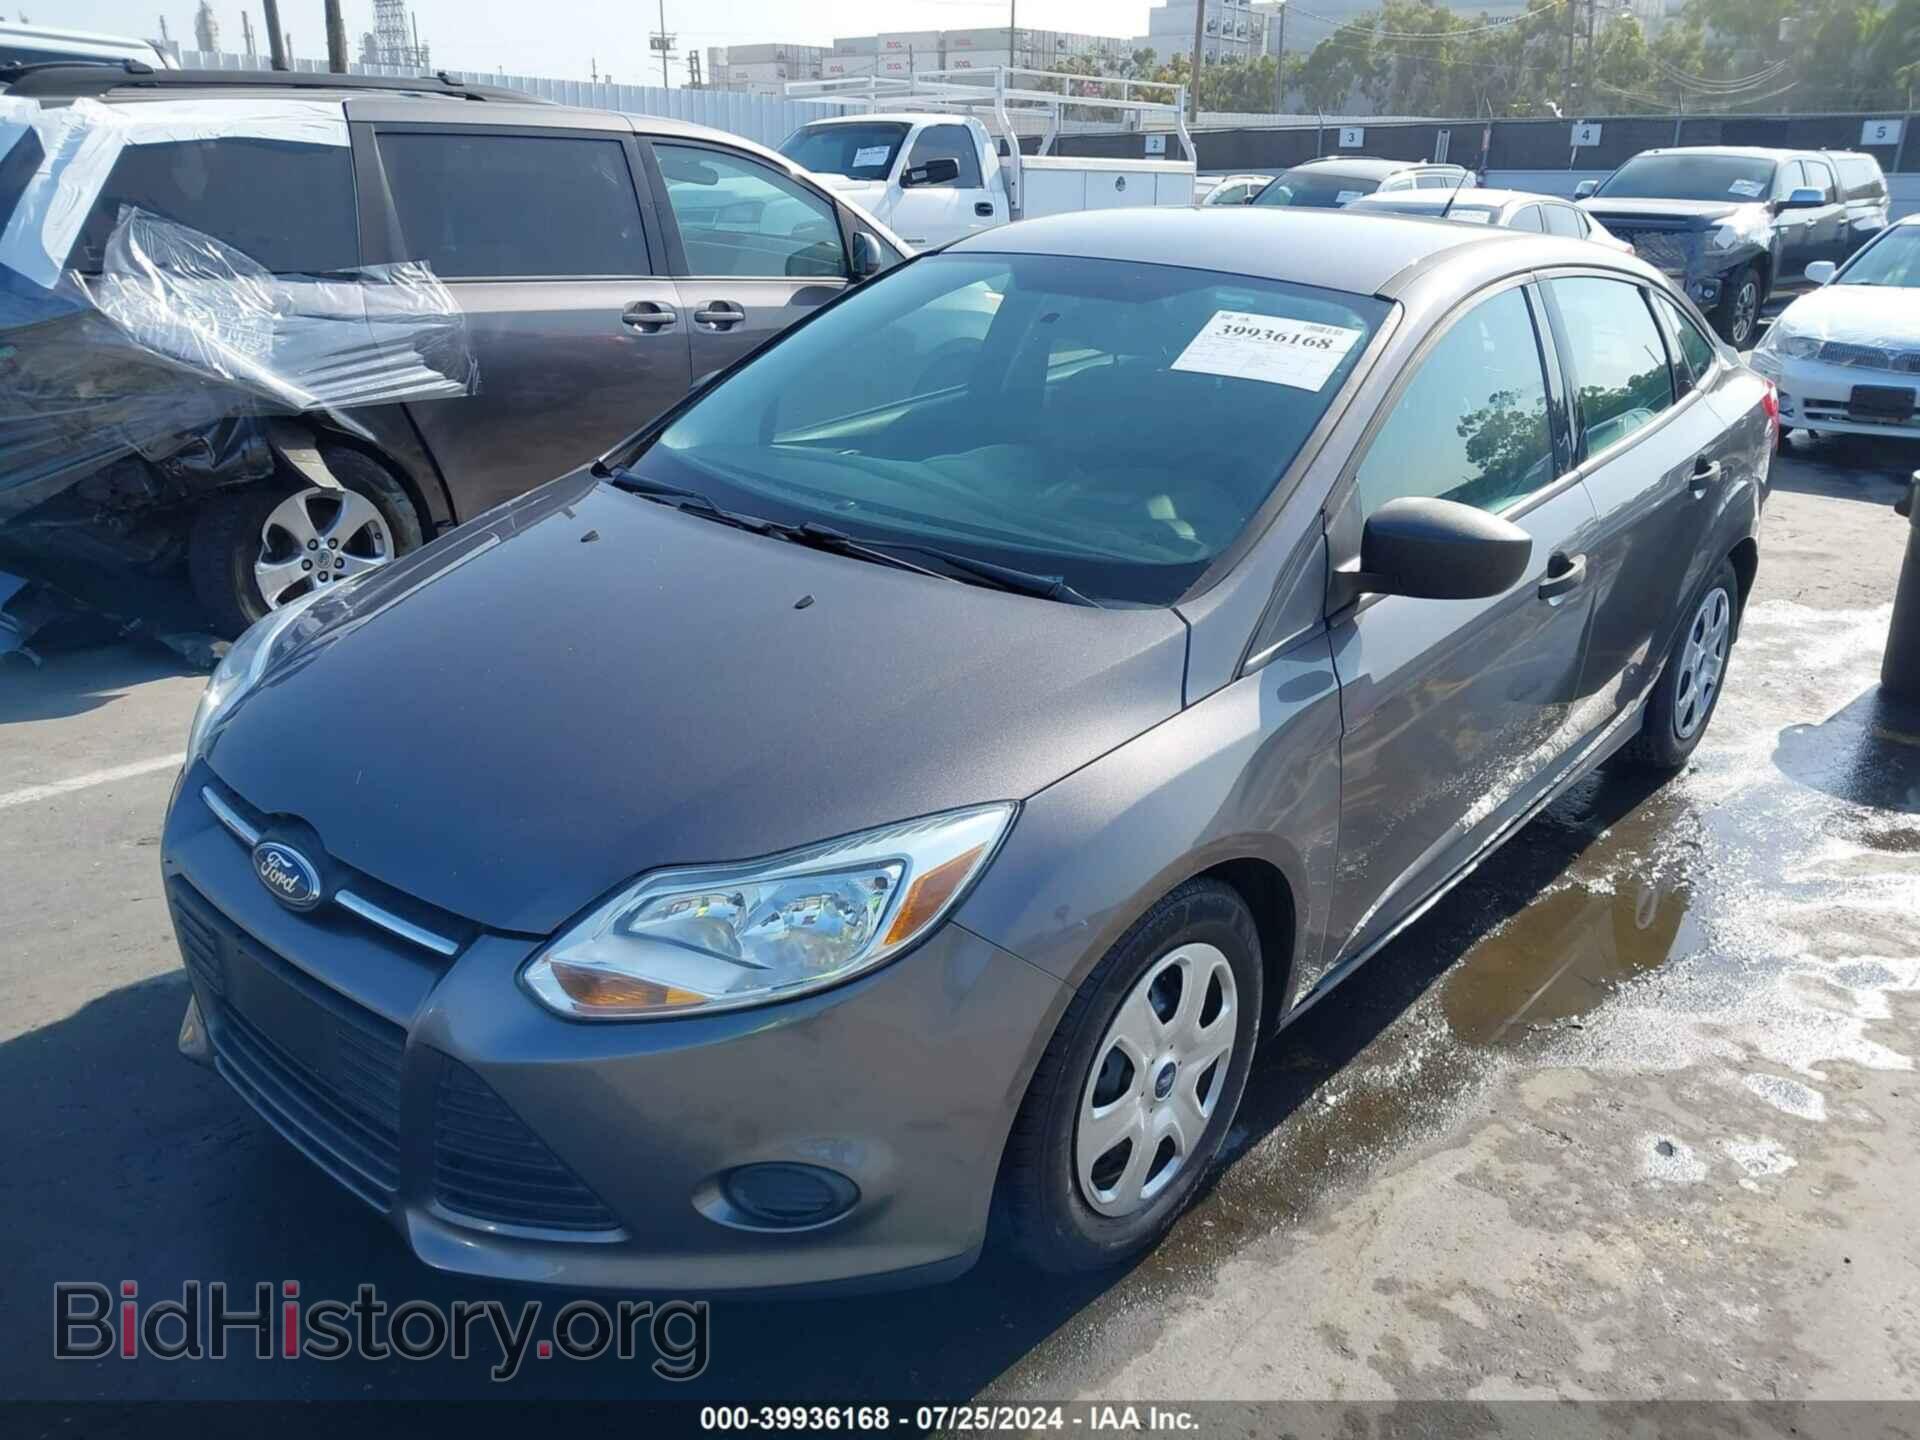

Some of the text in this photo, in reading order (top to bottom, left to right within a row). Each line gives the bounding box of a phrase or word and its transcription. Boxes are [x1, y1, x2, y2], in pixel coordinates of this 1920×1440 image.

[1348, 132, 1355, 143] 3
[1582, 129, 1590, 141] 4
[1877, 126, 1887, 138] 5
[1152, 139, 1159, 149] 2
[1215, 324, 1334, 350] 39936168
[260, 851, 300, 893] Ford
